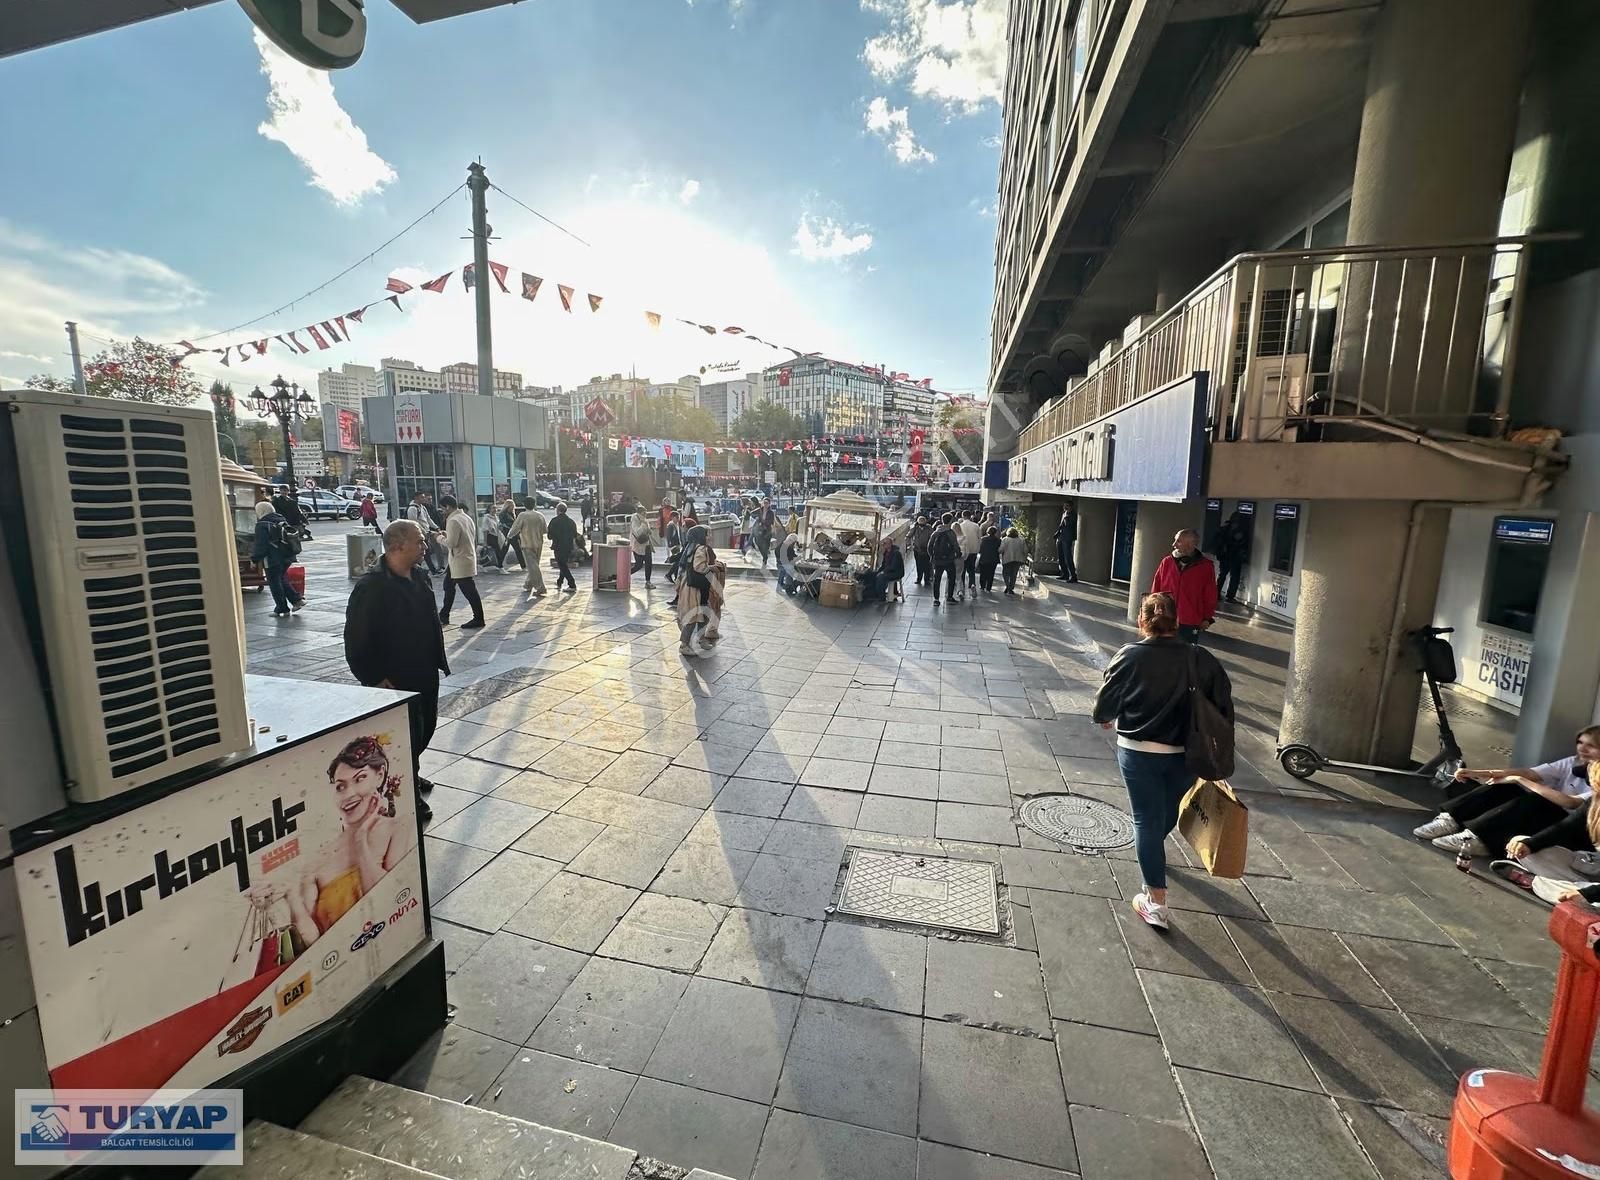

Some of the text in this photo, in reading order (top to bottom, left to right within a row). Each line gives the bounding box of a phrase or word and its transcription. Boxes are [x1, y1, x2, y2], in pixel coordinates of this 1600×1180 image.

[1270, 592, 1288, 609] CASH
[1481, 648, 1529, 674] INSTANT
[1478, 662, 1526, 697] CASH
[351, 921, 386, 952] CEYO
[283, 980, 306, 1007] CAT
